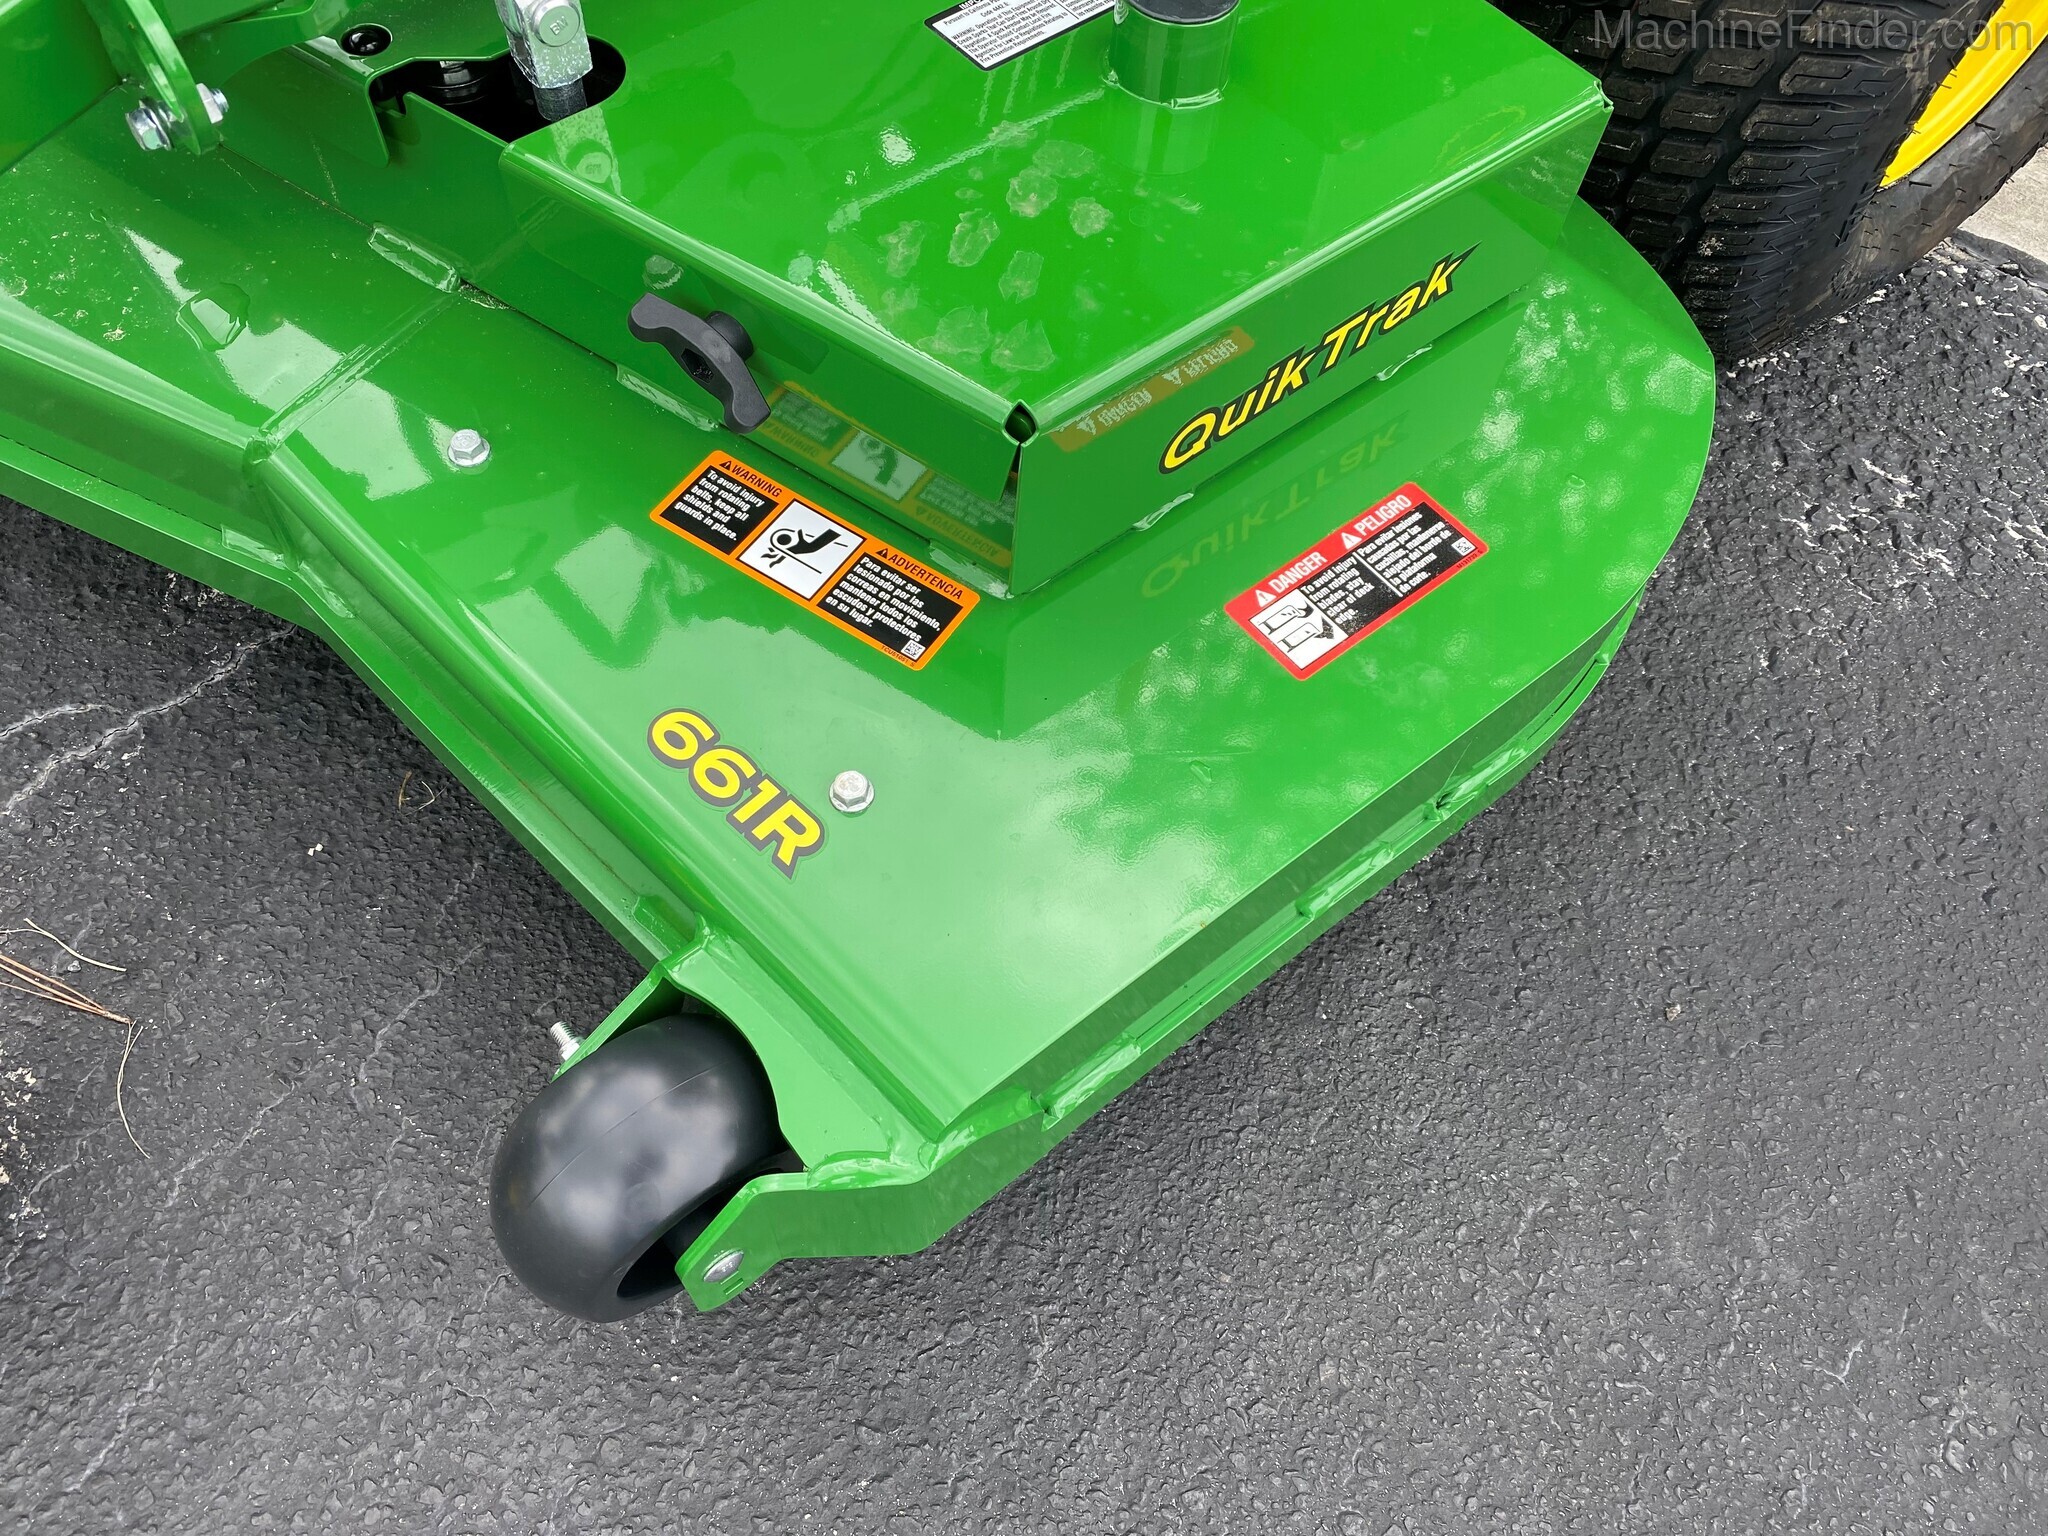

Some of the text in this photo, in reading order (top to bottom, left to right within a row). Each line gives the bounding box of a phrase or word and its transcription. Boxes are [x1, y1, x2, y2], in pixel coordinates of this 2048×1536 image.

[699, 478, 751, 512] from rotating
[707, 470, 765, 507] To avoid injury
[732, 465, 782, 497] WARNING
[674, 502, 736, 541] guards in place.
[683, 494, 731, 523] shields and
[691, 485, 749, 521] belts, keep all
[1354, 495, 1412, 536] PELIGRO
[1357, 512, 1423, 557] Para evitar lesiones
[1366, 525, 1422, 564] causadas por las
[1374, 521, 1446, 571] cuchillas, mantenerse
[1268, 552, 1327, 593] DANGER
[1382, 529, 1453, 580] alejado del borde de
[1389, 552, 1437, 586] la plataforma
[853, 564, 924, 608] lesionado por las
[860, 557, 921, 594] Para evitar ser
[888, 554, 963, 599] ADVERTENCIA
[1300, 556, 1357, 594] To avoid injury
[1309, 568, 1360, 602] from rotating
[1316, 574, 1366, 610] blades, stay
[1399, 571, 1431, 593] de corte.
[825, 596, 873, 627] en su lugar.
[832, 589, 922, 645] escudos y protectores
[839, 581, 918, 628] mantener todos los
[846, 573, 940, 631] correas en movimiento,
[1326, 582, 1375, 617] clear of deck
[1334, 608, 1359, 625] edge.
[649, 709, 824, 875] 661R
